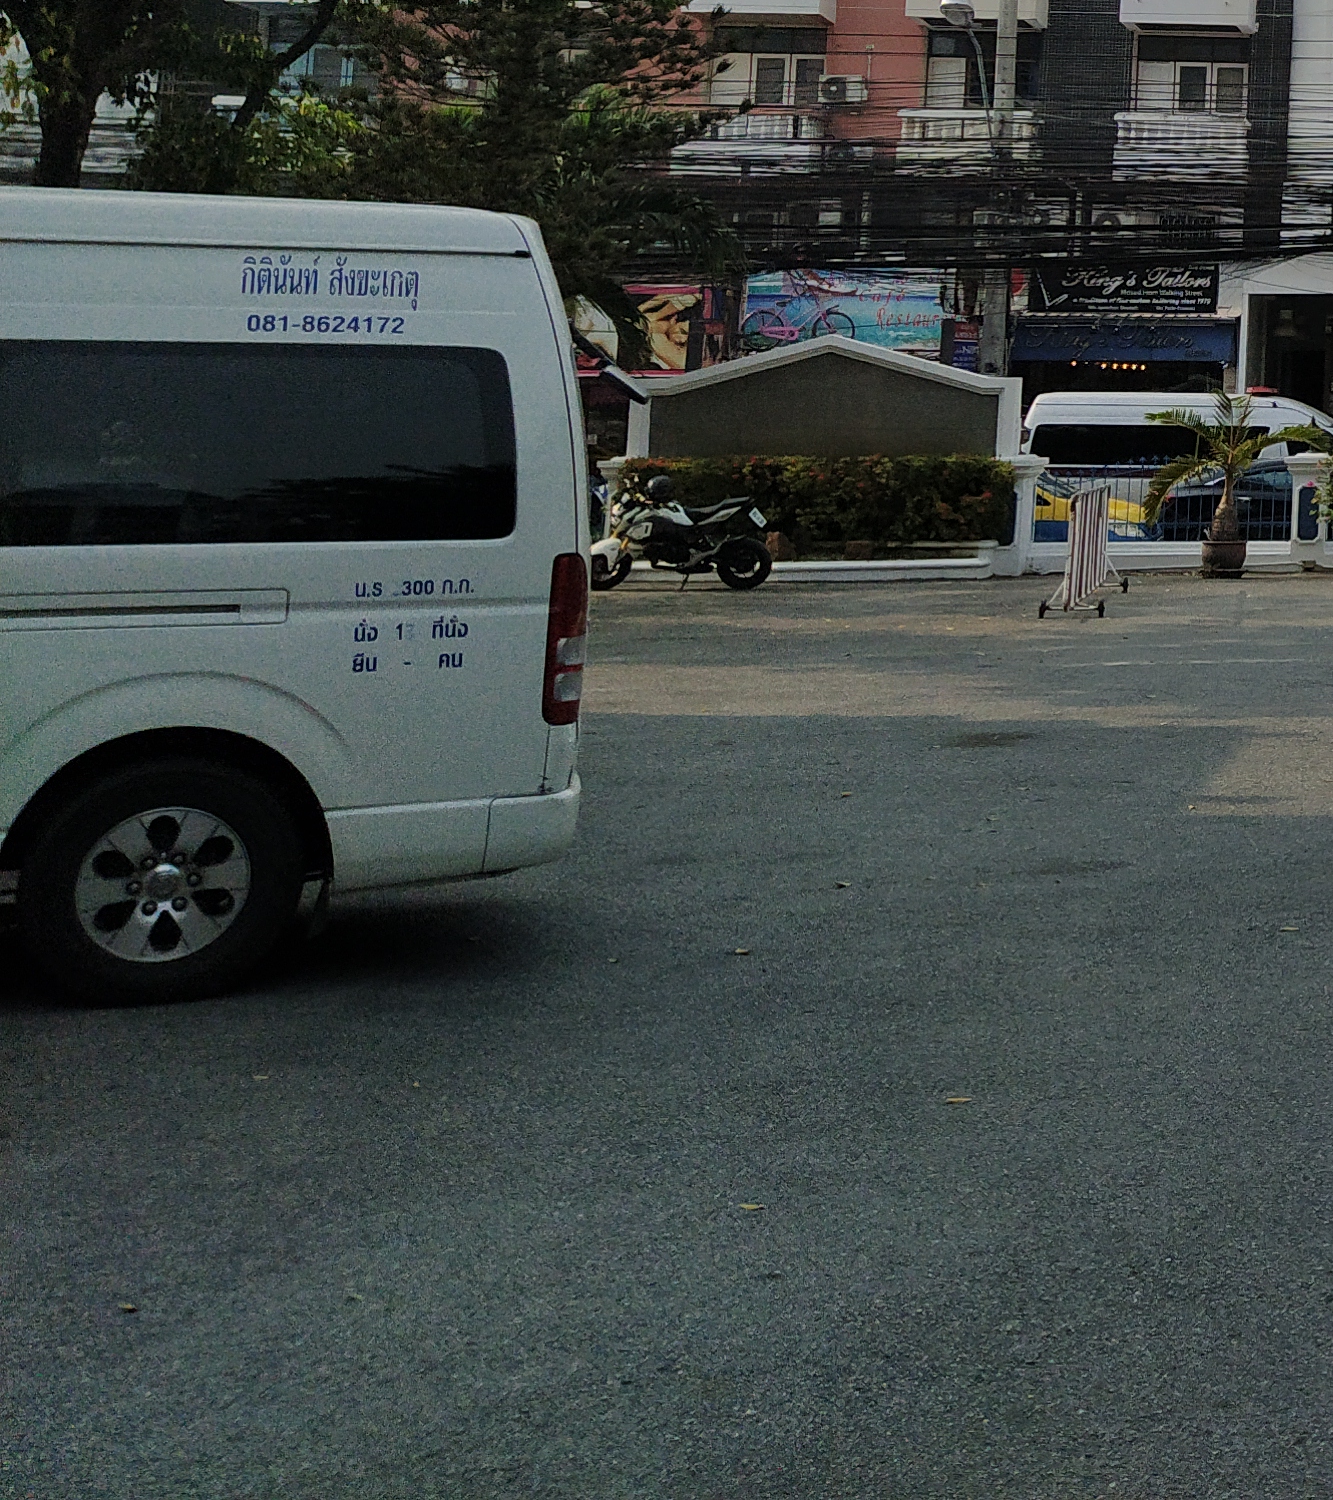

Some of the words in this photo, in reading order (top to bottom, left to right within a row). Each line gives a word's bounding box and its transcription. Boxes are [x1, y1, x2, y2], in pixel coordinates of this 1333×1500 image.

[241, 254, 320, 295] กิตินันท์
[1062, 266, 1137, 295] King's
[1142, 267, 1211, 288] Tailors
[1159, 288, 1183, 298] Walking
[1185, 289, 1203, 297] Street
[247, 314, 405, 334] 081-8624172
[876, 307, 958, 331] Restaur
[393, 580, 434, 596] 300
[354, 618, 378, 642] นั่ง
[432, 615, 469, 639] ที่นั่ง
[352, 653, 377, 673] ยืน
[439, 652, 463, 668] คน
